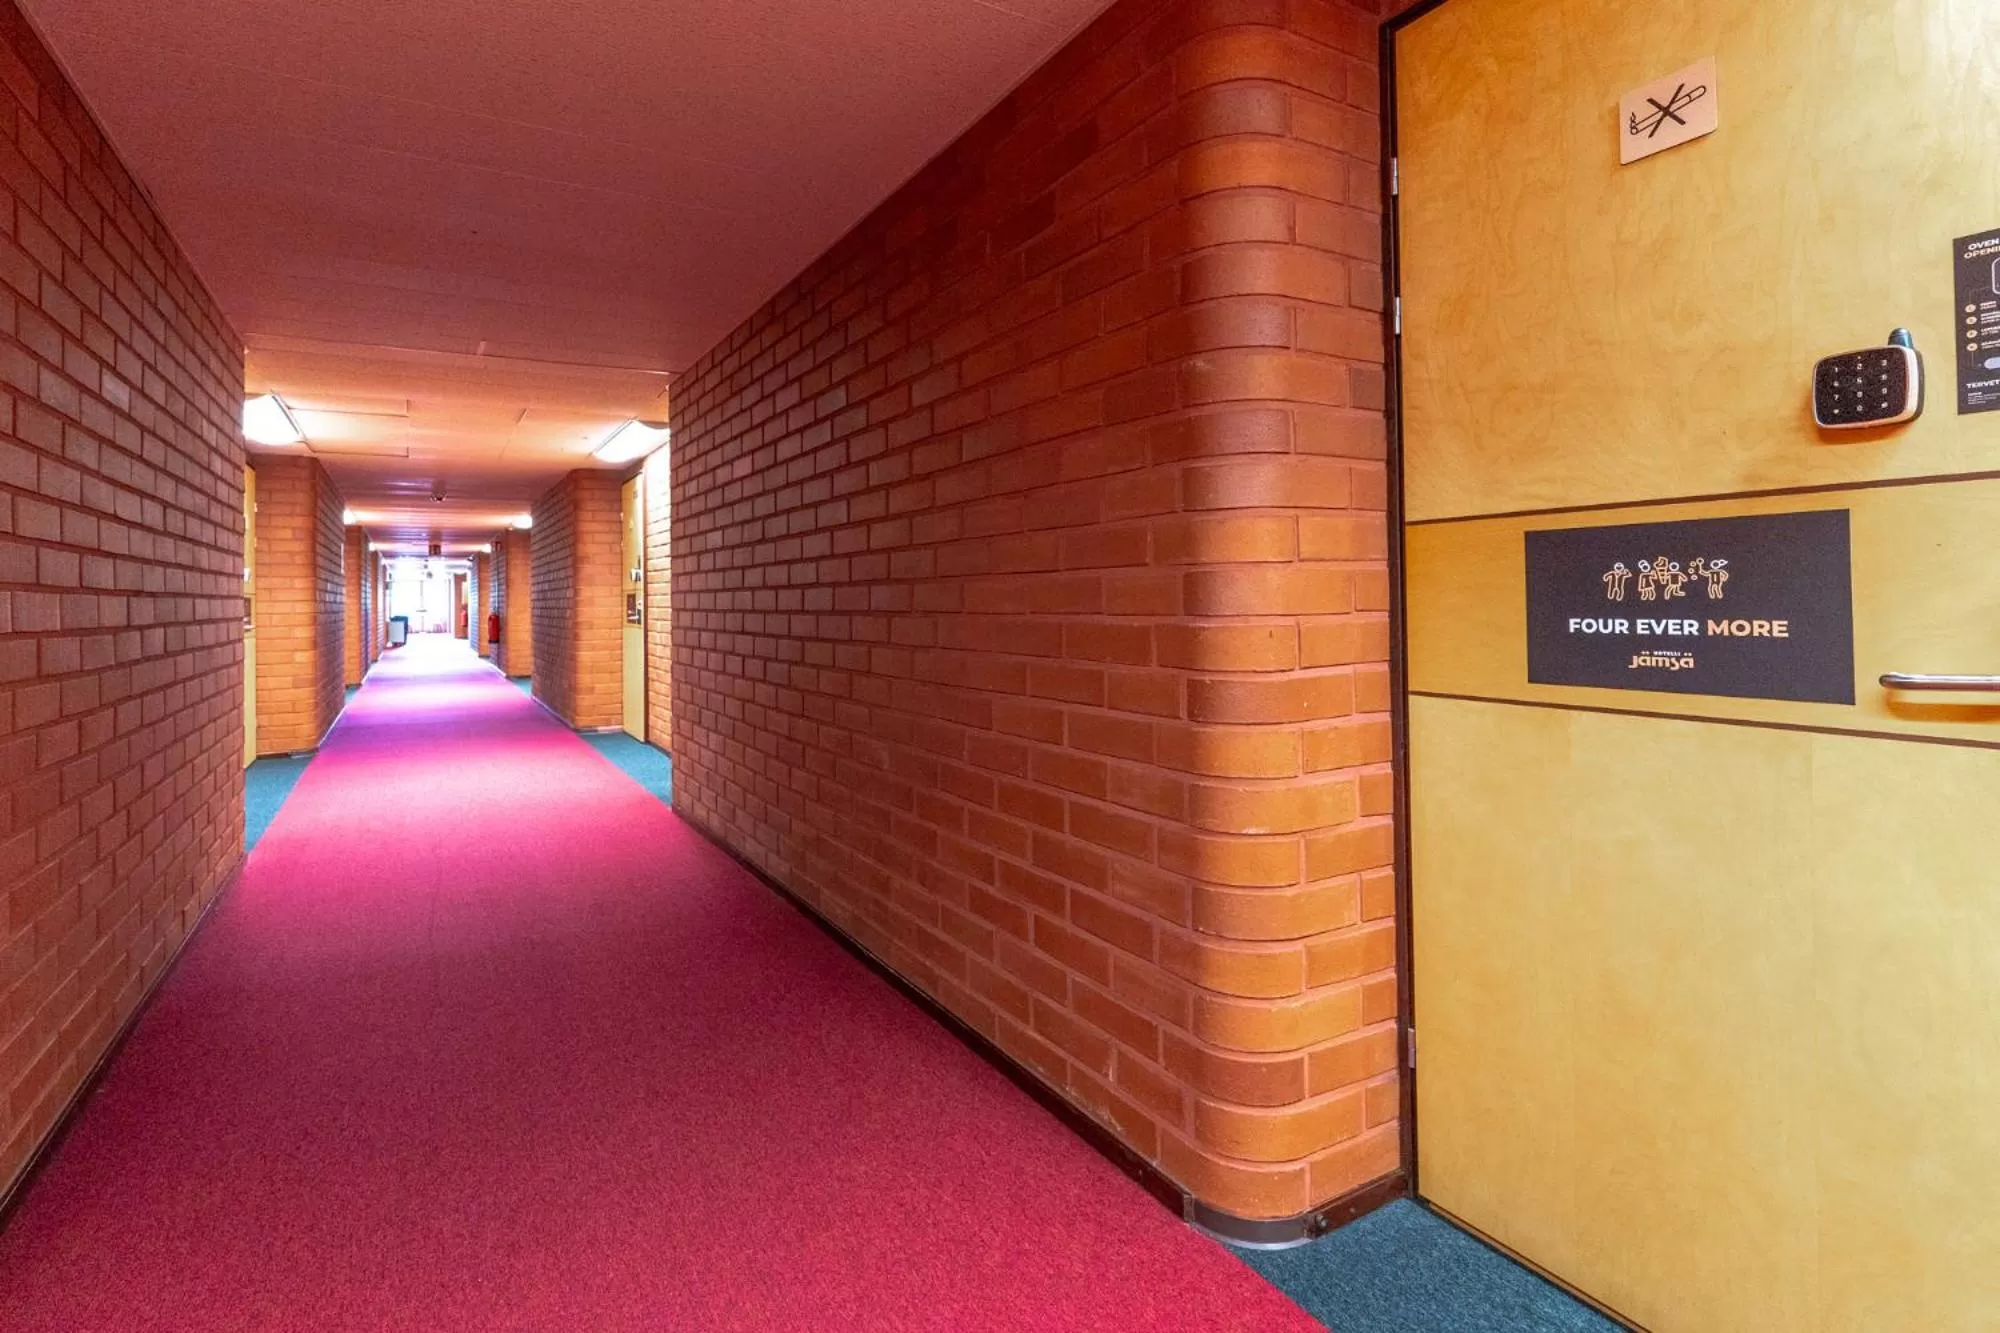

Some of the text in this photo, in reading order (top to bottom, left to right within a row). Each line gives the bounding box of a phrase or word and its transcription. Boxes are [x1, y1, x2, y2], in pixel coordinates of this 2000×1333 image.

[1968, 238, 2000, 250] OVEN
[1964, 246, 2000, 259] OPENI
[1569, 618, 1789, 638] FOUR EVER MORE
